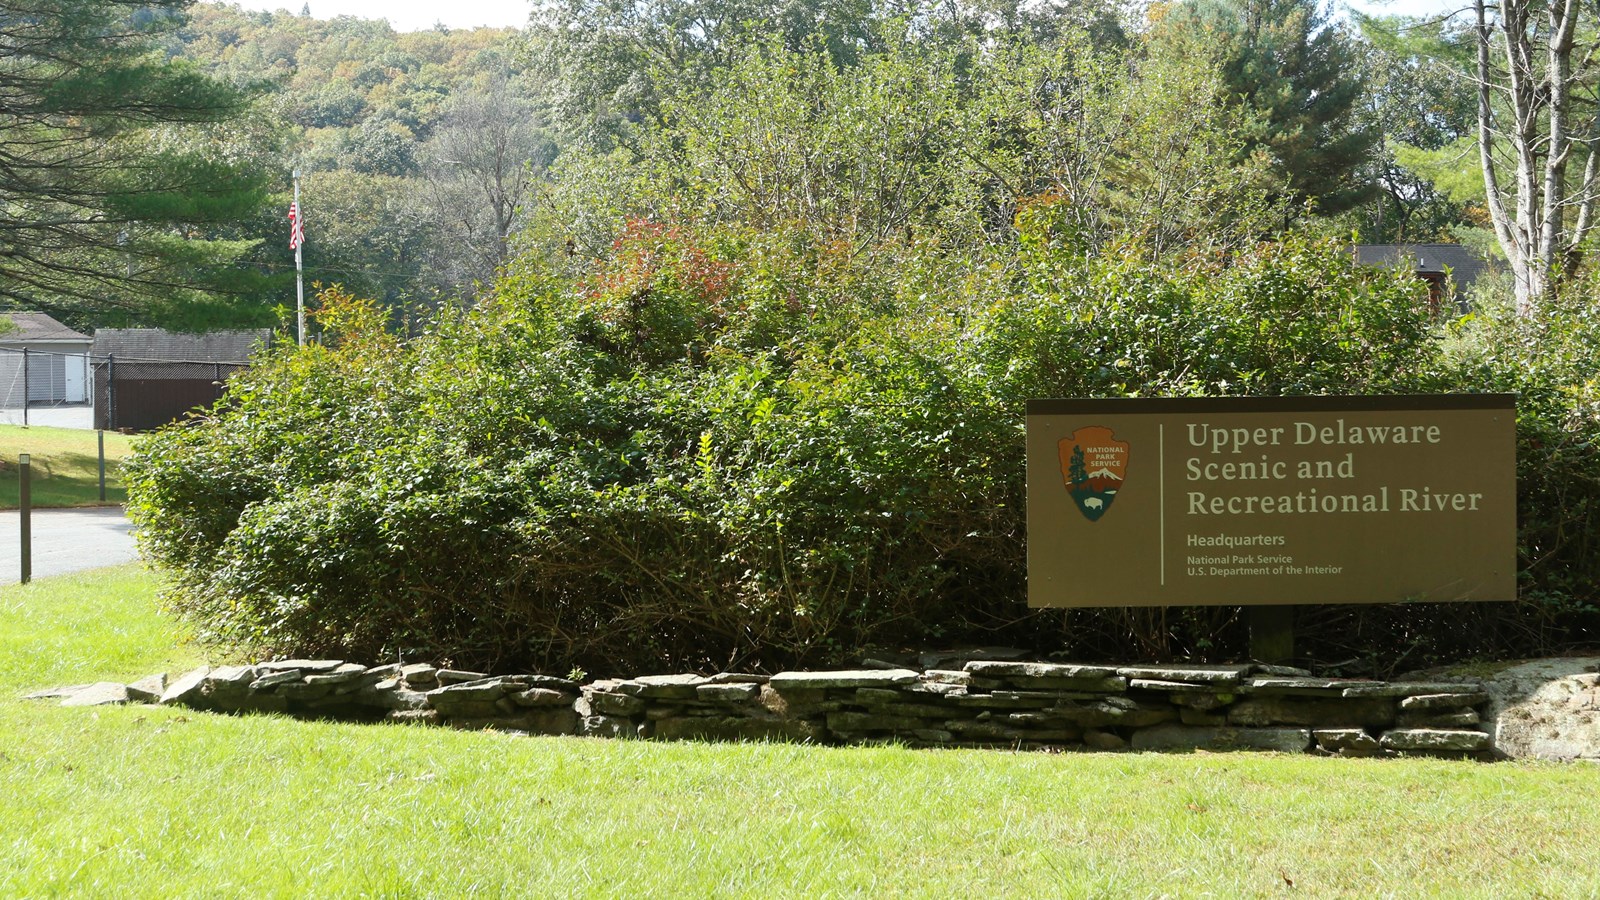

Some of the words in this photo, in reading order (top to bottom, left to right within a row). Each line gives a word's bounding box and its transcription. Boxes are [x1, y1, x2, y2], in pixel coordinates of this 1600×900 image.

[1187, 423, 1284, 453] Upper
[1294, 419, 1441, 445] Delaware
[1086, 446, 1125, 454] NATIONAL
[1186, 454, 1287, 481] Scenic
[1297, 453, 1355, 479] and
[1187, 487, 1389, 515] Recreational
[1400, 487, 1482, 512] River
[1187, 533, 1285, 549] Headquarters
[1187, 555, 1229, 565] National
[1232, 555, 1254, 565] Park
[1257, 554, 1293, 564] Service
[1187, 567, 1207, 576] U.S.
[1210, 566, 1269, 577] Department
[1272, 566, 1283, 575] of
[1285, 565, 1302, 575] the
[1305, 565, 1342, 575] Interior
